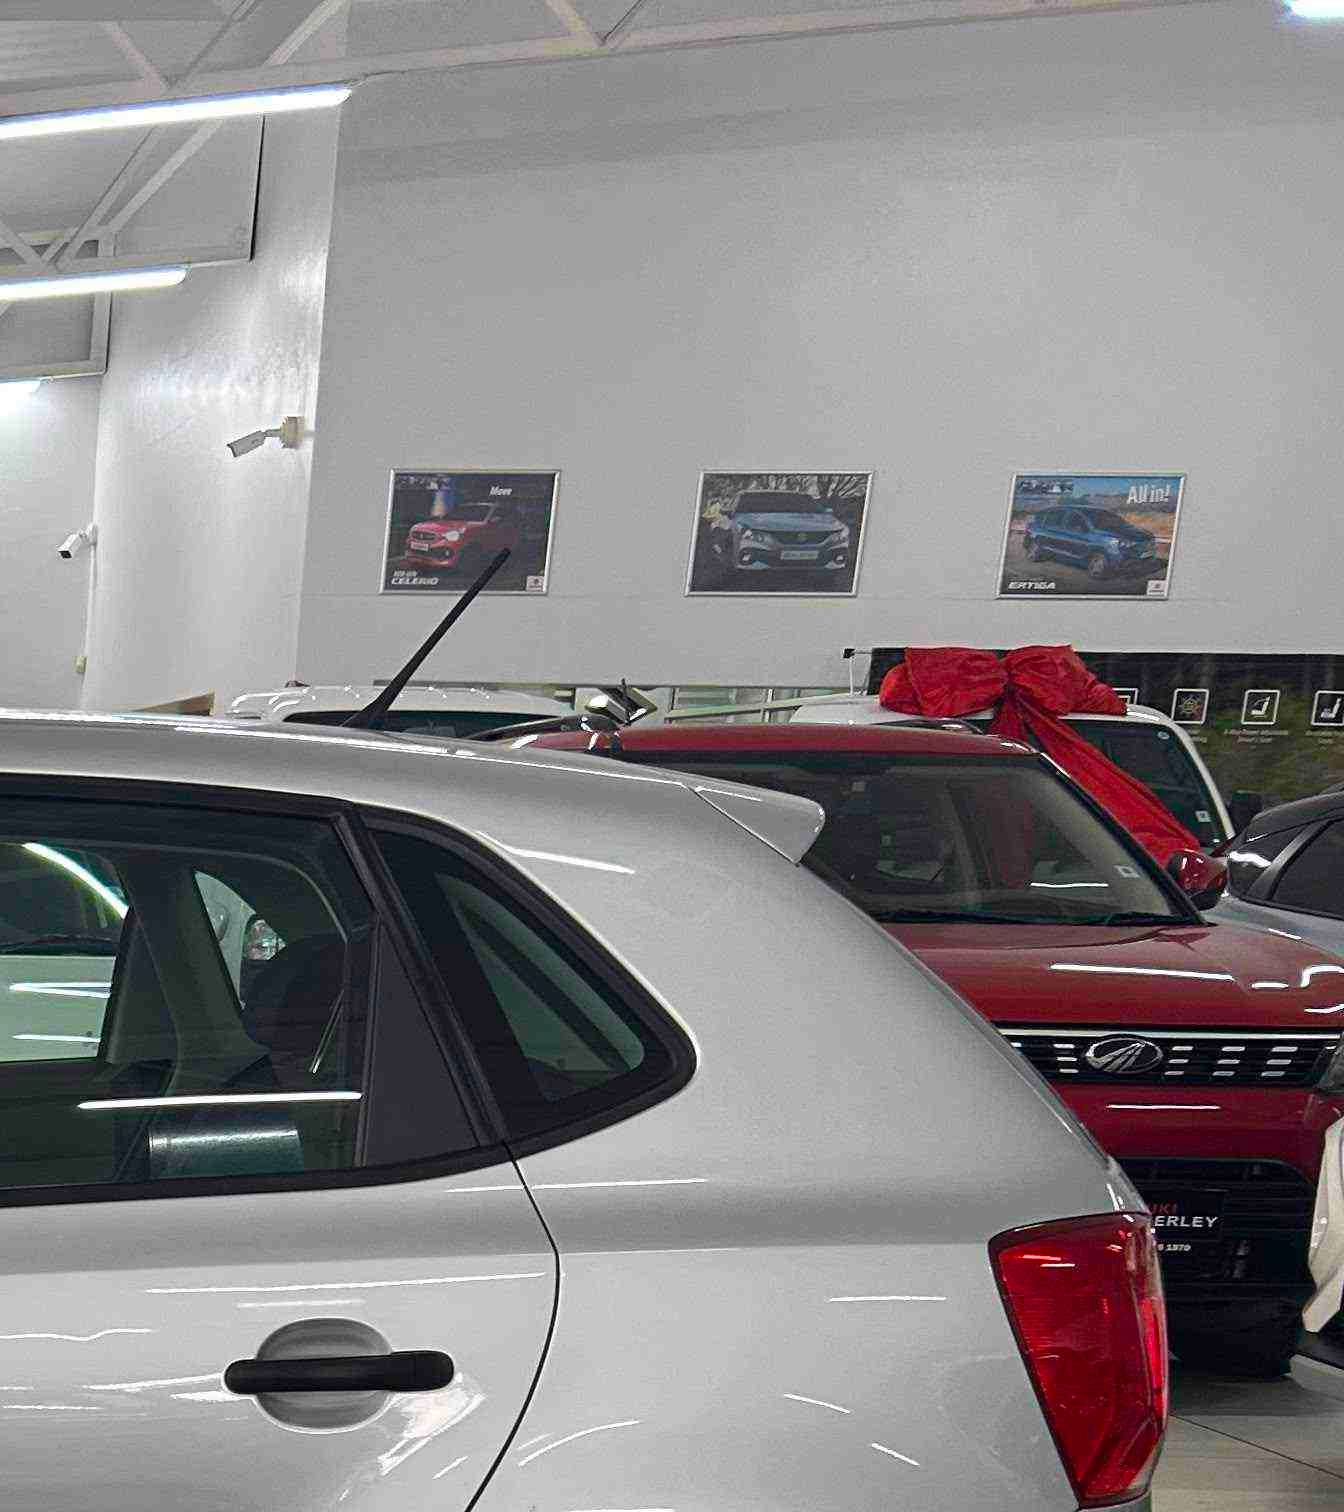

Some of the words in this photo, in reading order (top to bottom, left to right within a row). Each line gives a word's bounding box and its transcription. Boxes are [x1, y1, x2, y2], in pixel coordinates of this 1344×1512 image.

[391, 577, 440, 586] CELERIO
[1008, 581, 1057, 590] ERTIGA
[1154, 1215, 1219, 1228] ERLEY
